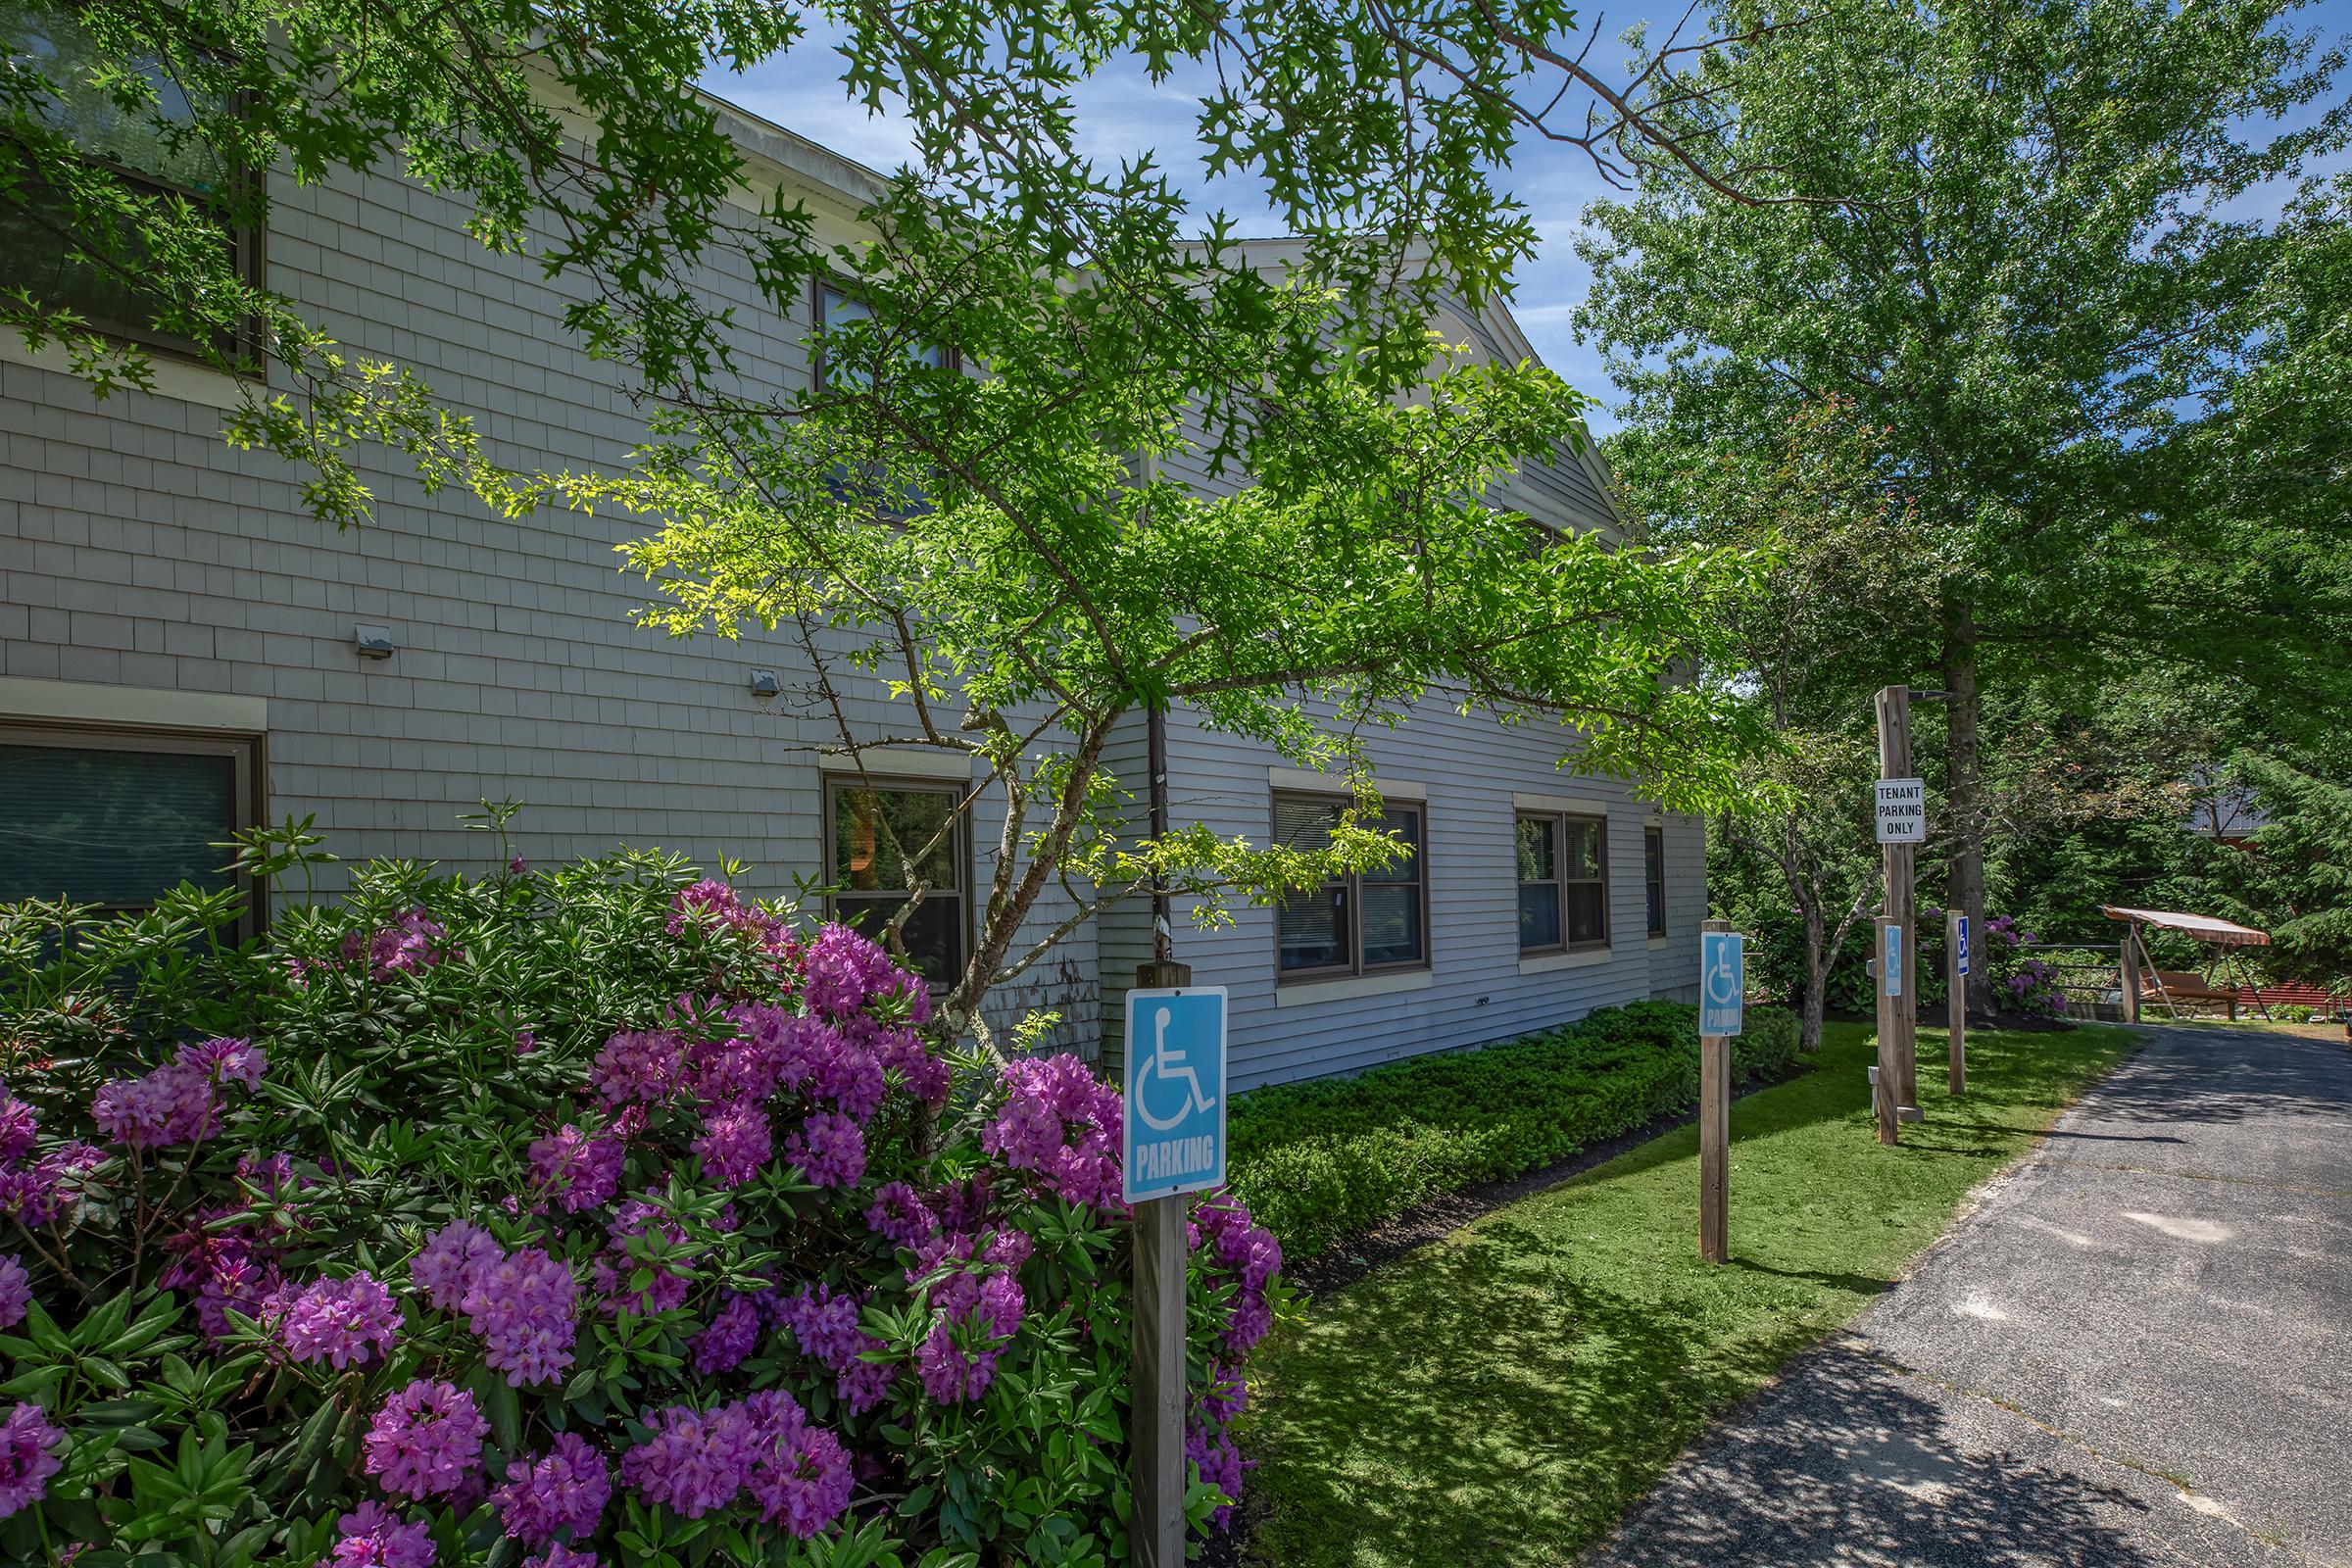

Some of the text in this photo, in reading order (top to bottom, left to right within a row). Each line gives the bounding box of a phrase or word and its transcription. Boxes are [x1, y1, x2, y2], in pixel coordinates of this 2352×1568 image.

[1879, 787, 1920, 799] TENANT
[1879, 805, 1922, 816] PARKING
[1886, 822, 1914, 834] ONLY
[1136, 1135, 1214, 1182] PARKING
